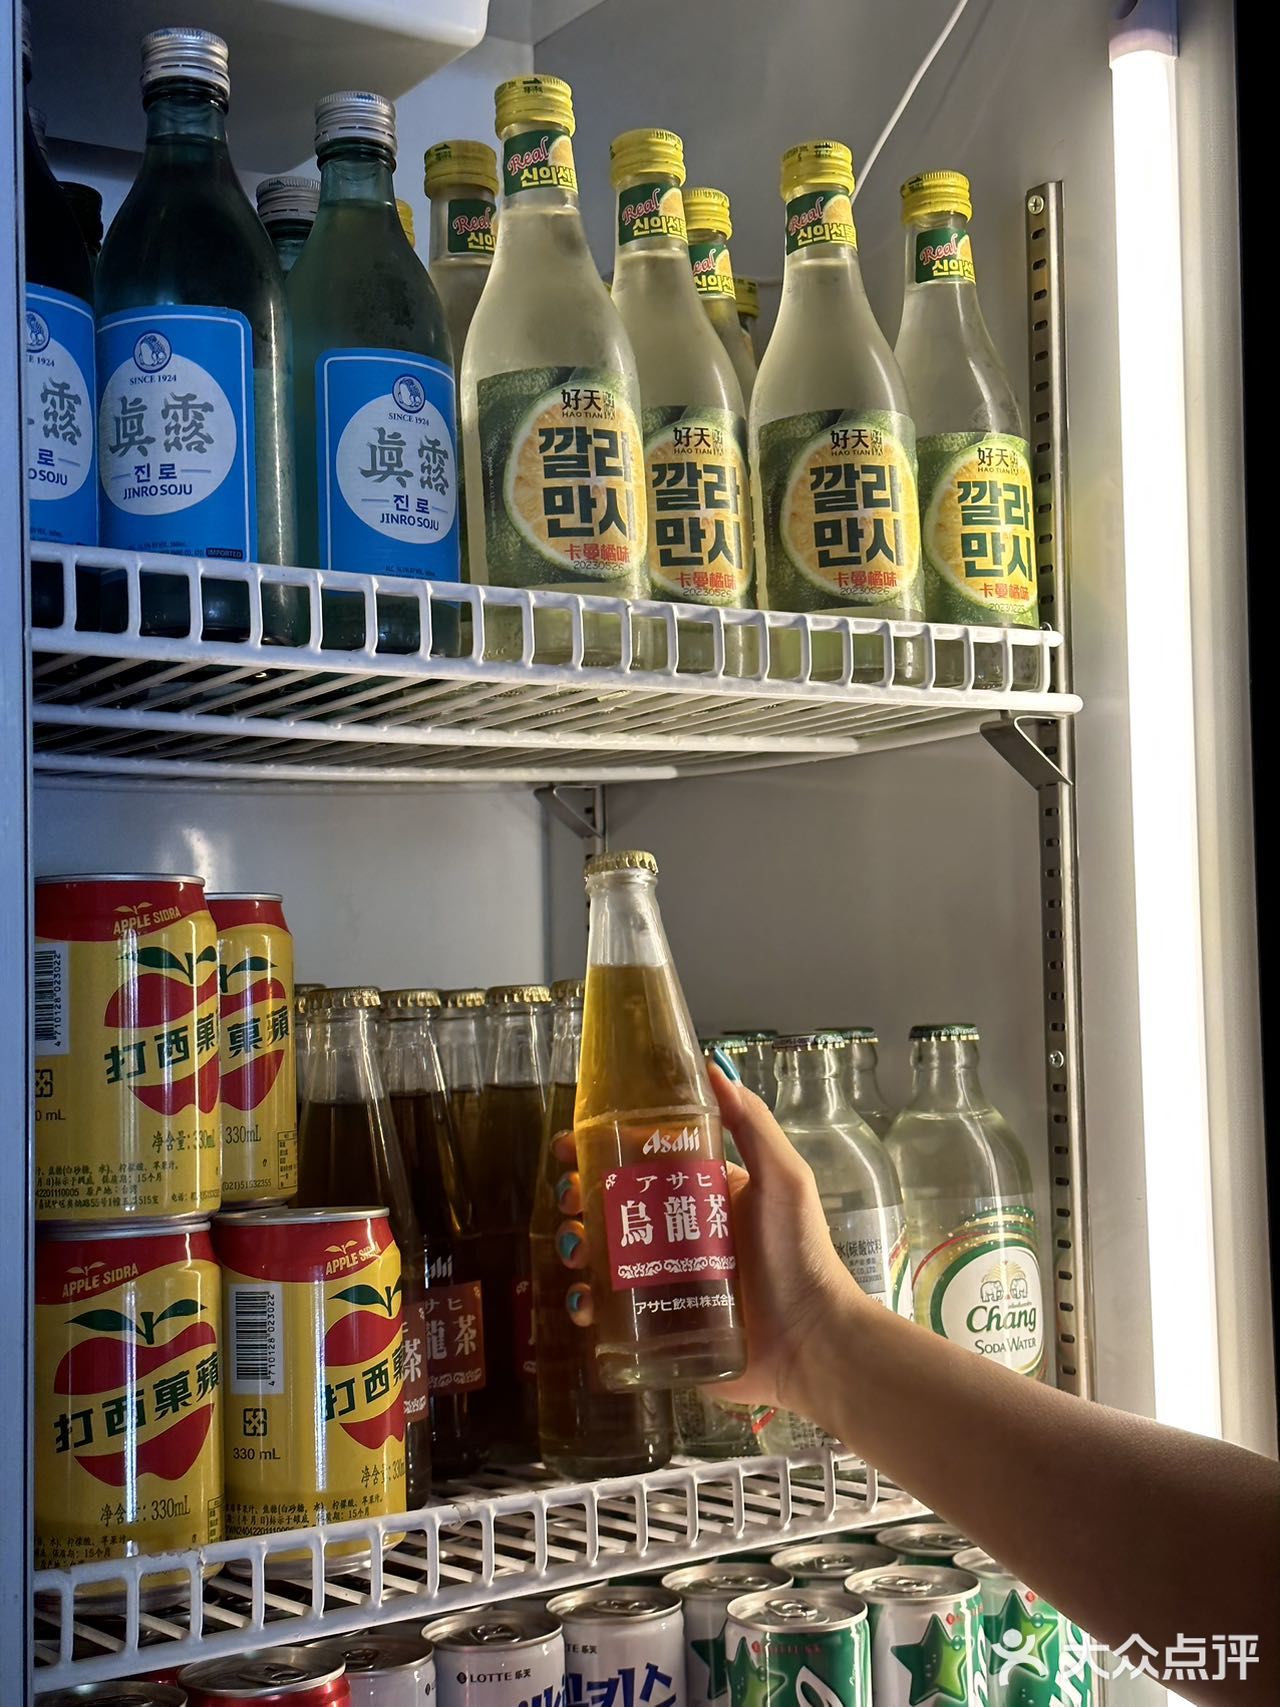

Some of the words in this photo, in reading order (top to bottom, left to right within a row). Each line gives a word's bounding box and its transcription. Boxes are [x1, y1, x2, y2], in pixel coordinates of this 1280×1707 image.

[507, 136, 549, 176] Real
[622, 188, 660, 225] Real
[788, 197, 823, 236] Real
[693, 248, 716, 274] eal
[920, 233, 958, 265] Real
[129, 376, 154, 386] SINCE
[158, 374, 177, 383] 1924
[388, 412, 414, 424] SINCE
[415, 417, 430, 426] 1924
[39, 470, 68, 486] SOJU
[123, 486, 158, 500] JINRO
[160, 483, 193, 496] SOJU
[380, 512, 416, 527] JINRO
[418, 517, 440, 531] SOJU
[543, 485, 636, 541] 만시
[655, 517, 743, 569] 만시
[814, 517, 905, 568] 만시
[960, 531, 1033, 582] 만시
[113, 913, 152, 935] APPLE
[153, 906, 181, 924] SIDRA
[225, 1124, 262, 1144] 330mL
[643, 1127, 700, 1154] Asahi
[636, 1172, 713, 1193] アサヒ
[325, 1252, 358, 1276] APPLE
[62, 1275, 100, 1298] APPLE
[102, 1263, 139, 1285] SIDRA
[966, 1305, 1037, 1333] Chang
[233, 1448, 256, 1460] 330
[259, 1447, 281, 1460] mL
[470, 1671, 513, 1684] LOTTE
